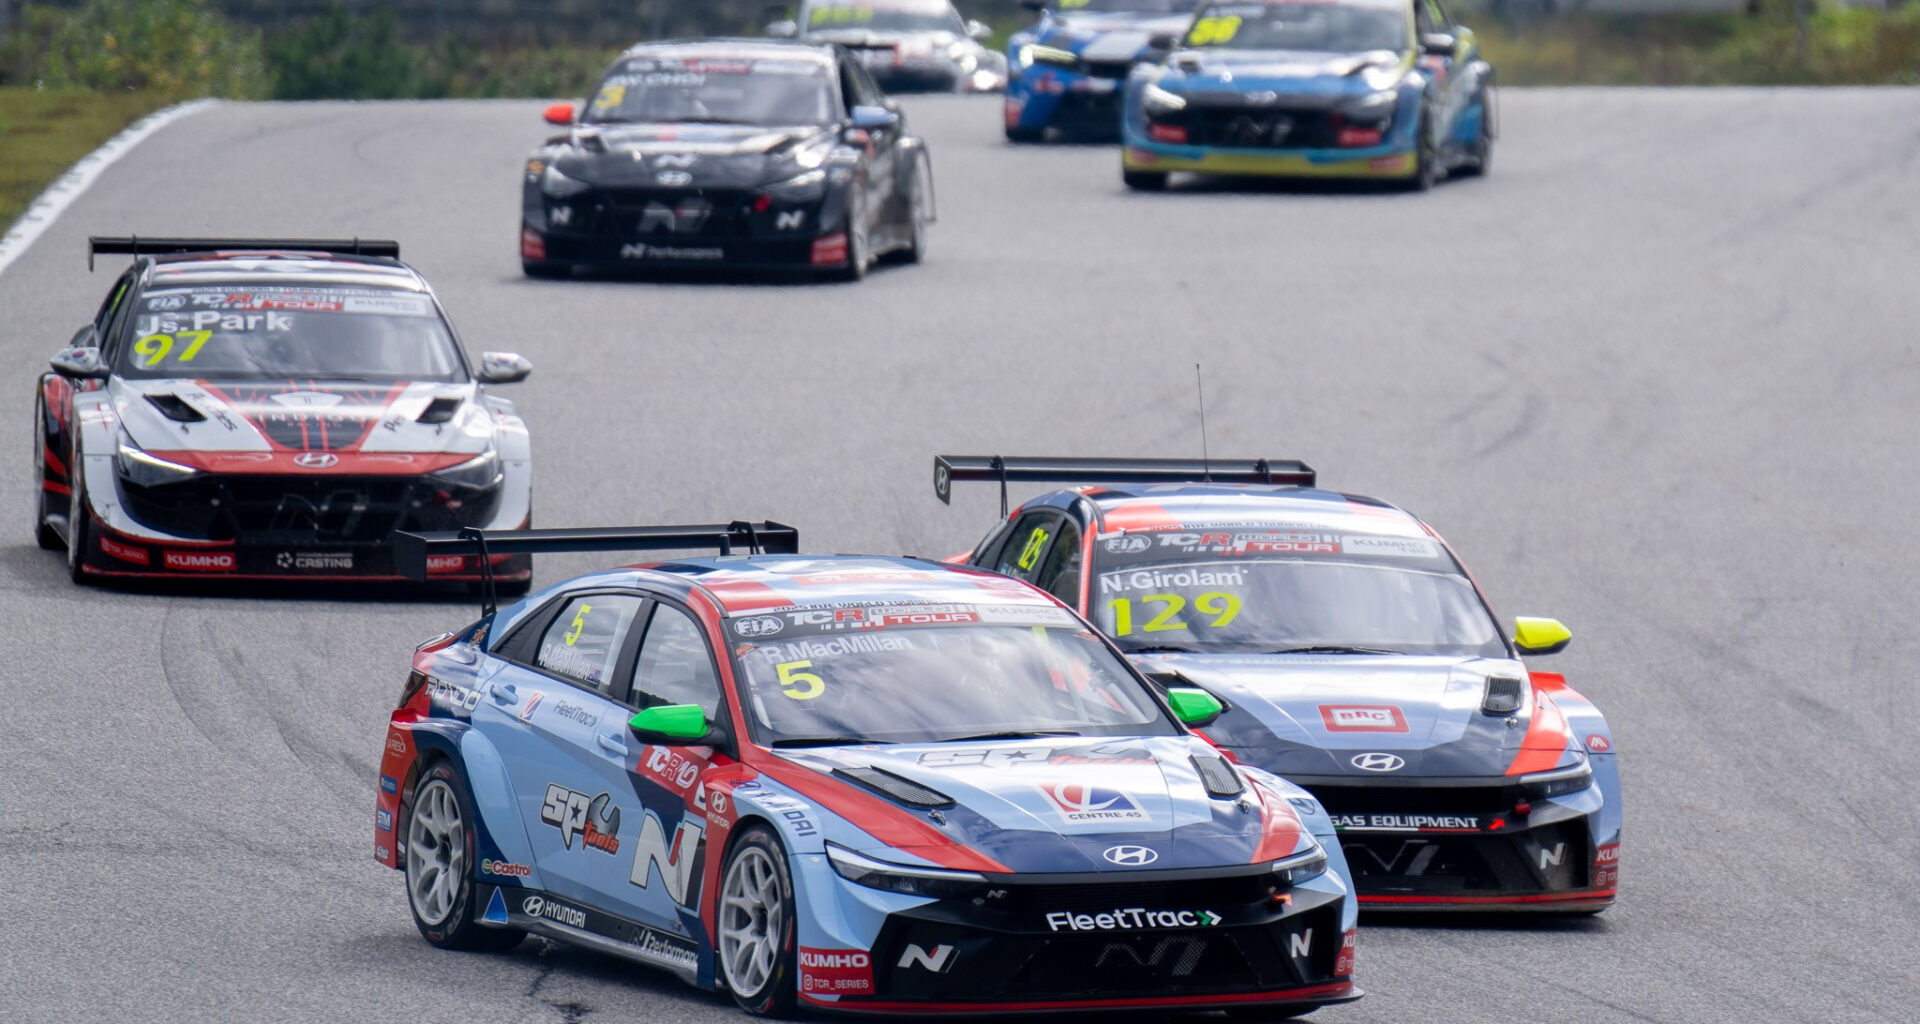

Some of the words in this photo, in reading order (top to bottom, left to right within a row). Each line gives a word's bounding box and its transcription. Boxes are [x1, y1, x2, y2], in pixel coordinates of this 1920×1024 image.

[272, 301, 338, 310] TOUR
[135, 330, 212, 366] 97
[1106, 536, 1147, 551] FIA
[1157, 533, 1231, 546] TCR
[1253, 542, 1333, 551] TOUR
[168, 553, 232, 567] KUMHO
[427, 557, 462, 569] MHO
[1101, 568, 1248, 594] N.Girolam
[739, 618, 781, 635] FIA
[786, 609, 864, 626] TCR
[889, 613, 972, 624] TOUR
[1108, 592, 1242, 636] 129
[566, 604, 592, 647] 5
[761, 634, 914, 664] R.MacMillan
[776, 660, 825, 700] 5
[554, 700, 592, 728] FleetTrac
[1340, 710, 1387, 721] BRC
[707, 811, 730, 831] HYUNDAI
[1069, 812, 1122, 821] CENTRE
[1125, 811, 1142, 819] 45
[1371, 816, 1478, 828] EQUIPMENT
[1597, 848, 1619, 862] KUM
[492, 860, 531, 876] Castrol
[545, 901, 586, 929] HYUNDAI
[1046, 908, 1198, 931] FleetTrac
[800, 952, 869, 968] KUMHO
[814, 978, 869, 990] TCR_SERIES
